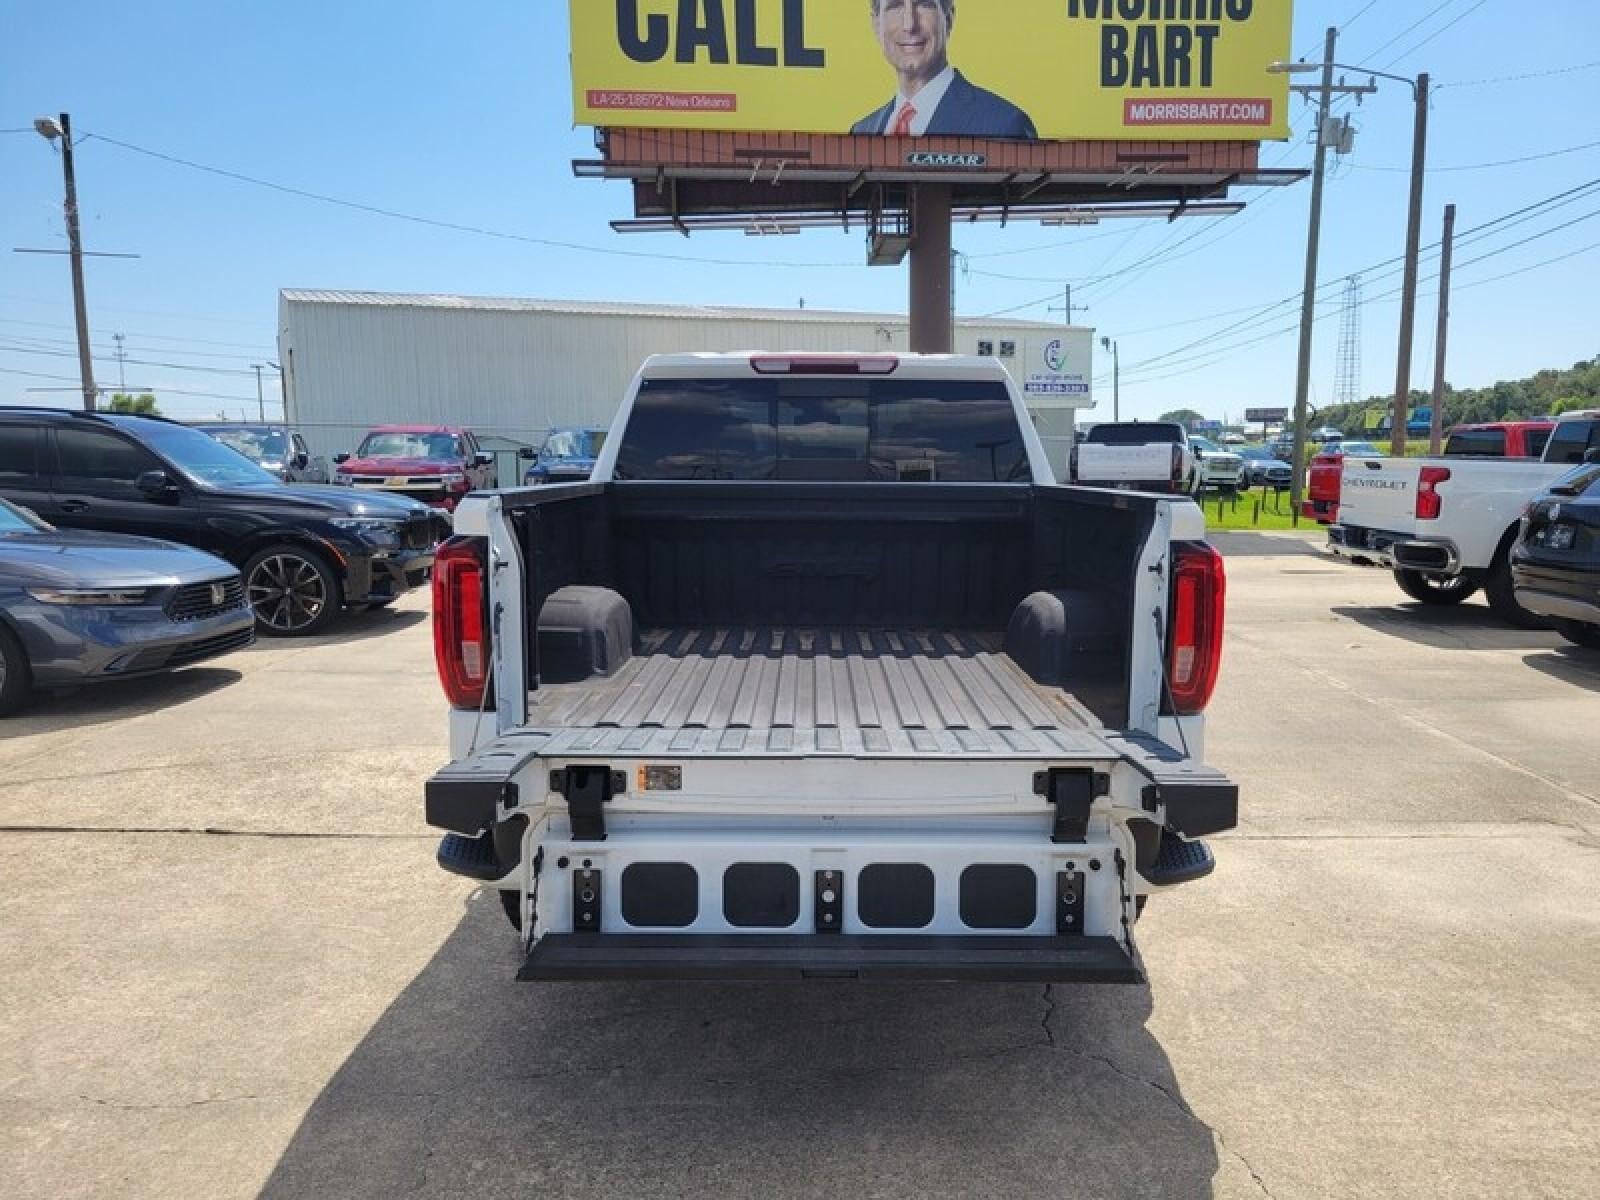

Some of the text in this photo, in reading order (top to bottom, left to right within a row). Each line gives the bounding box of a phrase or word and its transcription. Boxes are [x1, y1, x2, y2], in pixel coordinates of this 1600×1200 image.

[1100, 24, 1220, 89] BART
[665, 95, 688, 107] New
[691, 95, 730, 108] Orleans
[1130, 103, 1265, 120] MORRISBART.COM
[911, 153, 979, 165] LAMAR
